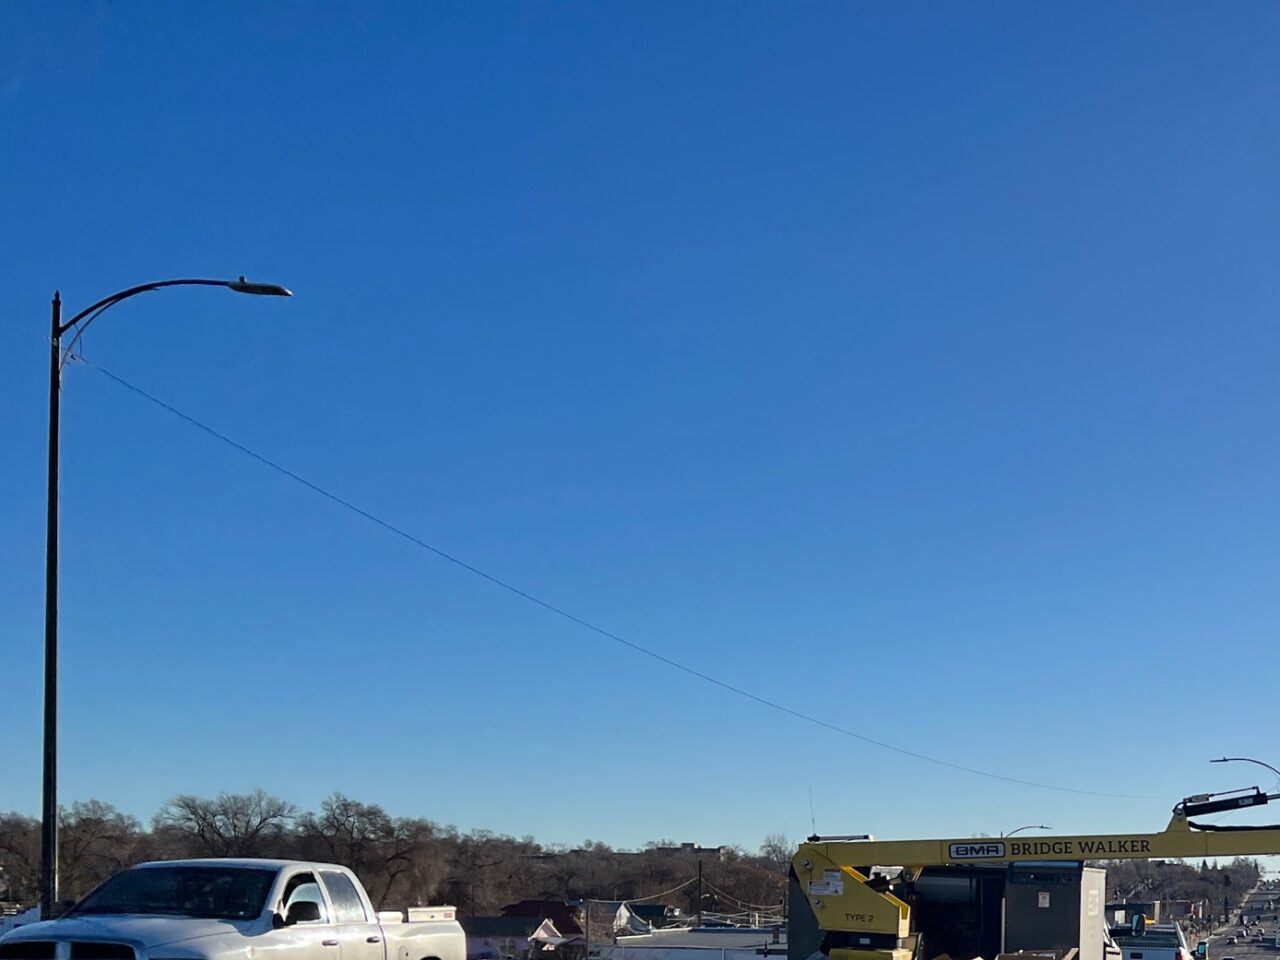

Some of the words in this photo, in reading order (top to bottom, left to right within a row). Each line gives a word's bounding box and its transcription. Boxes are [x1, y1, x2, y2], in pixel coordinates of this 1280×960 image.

[1011, 841, 1073, 856] BRIDGE
[1078, 839, 1151, 854] WALKER
[845, 913, 866, 922] TYPE
[868, 914, 874, 923] 2
